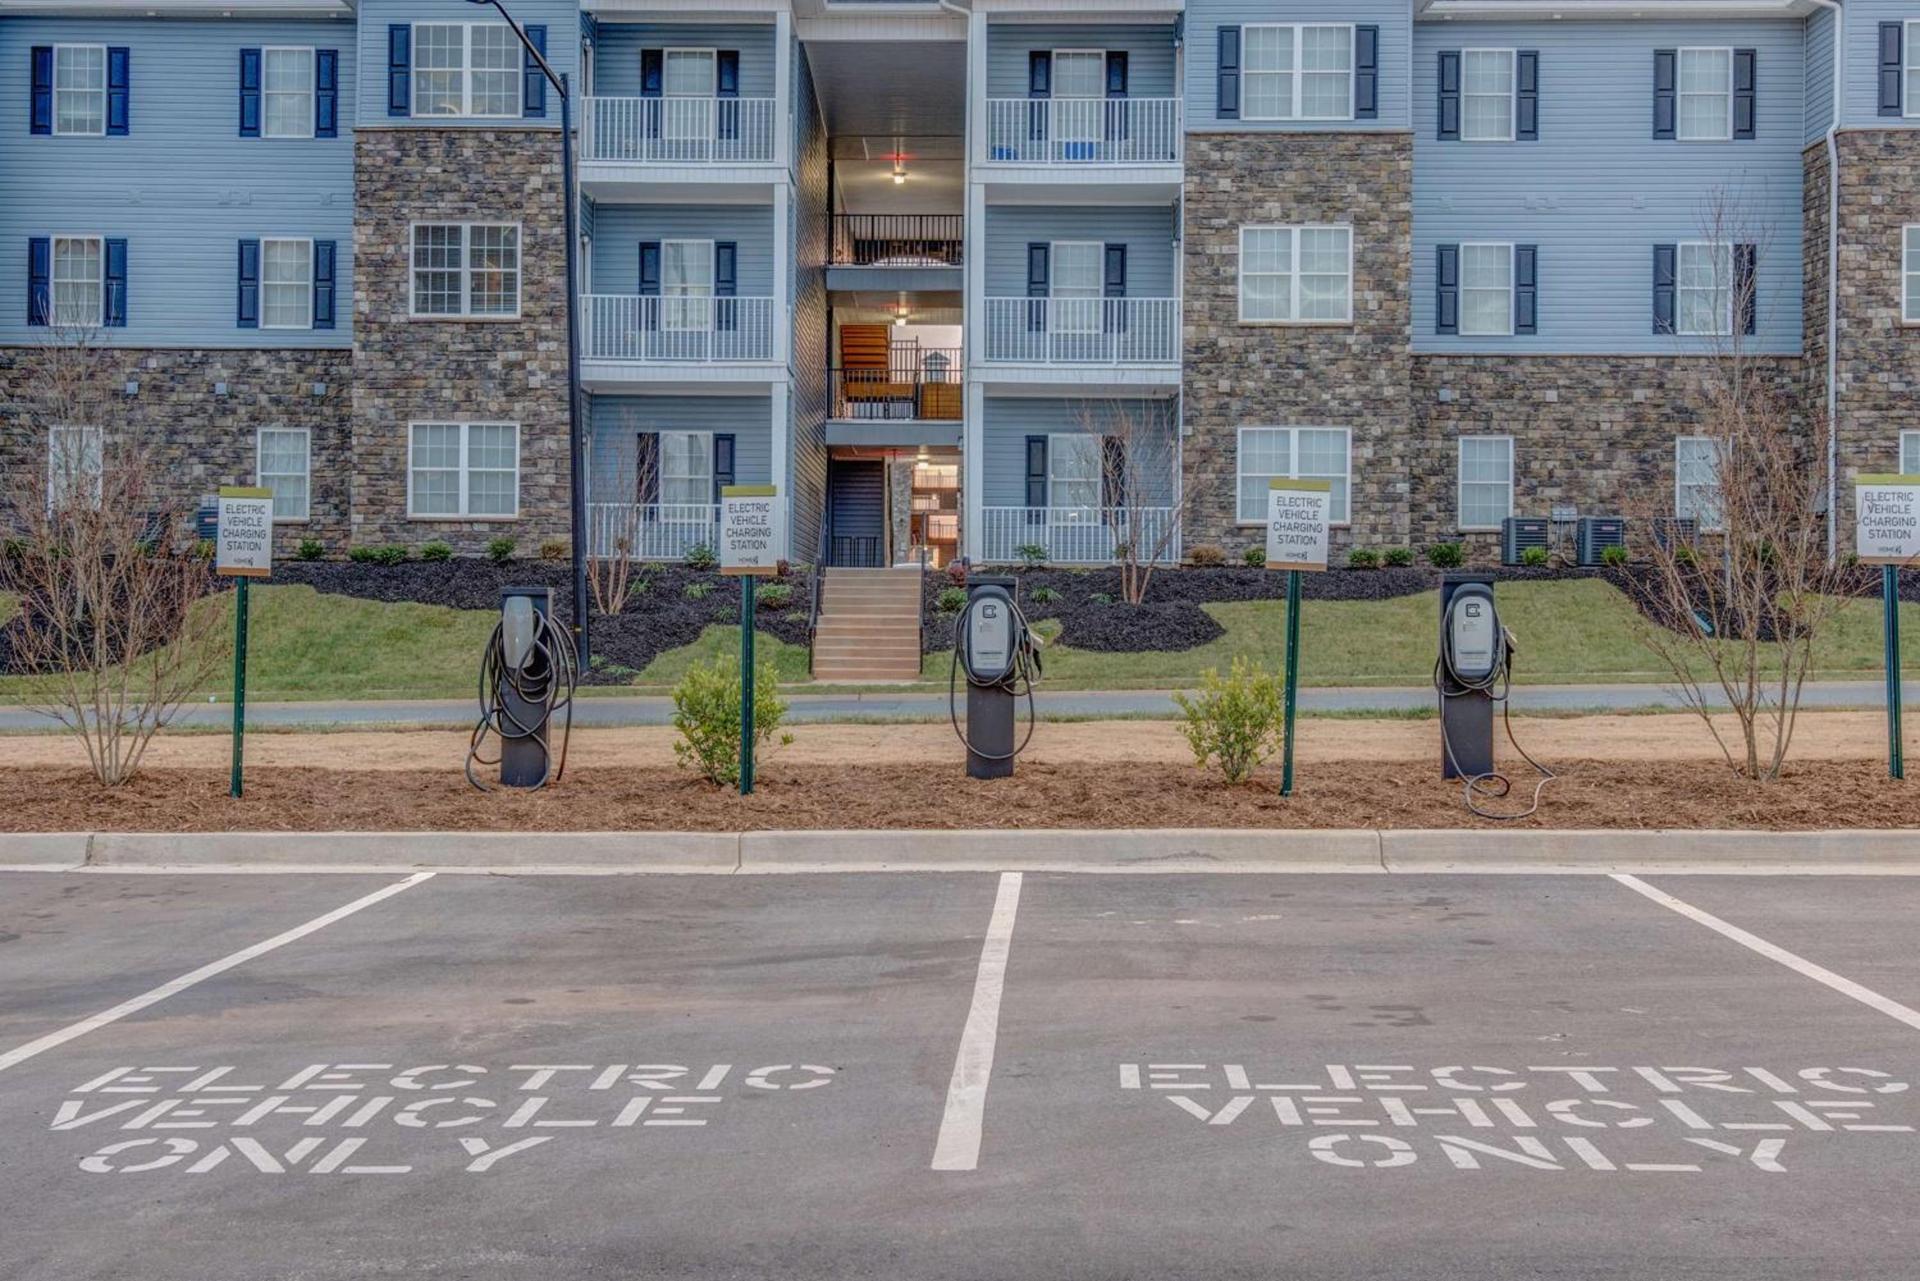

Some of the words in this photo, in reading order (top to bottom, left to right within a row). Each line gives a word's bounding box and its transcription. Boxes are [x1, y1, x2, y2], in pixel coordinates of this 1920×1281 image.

[1276, 496, 1323, 508] ELECTRIC
[1864, 491, 1914, 502] ELECTRIC
[225, 503, 266, 515] ELECTRIC
[728, 503, 770, 513] ELECTRIC
[1867, 503, 1912, 514] VEHICLE
[730, 515, 768, 525] VEHICLE
[1278, 509, 1320, 521] VEHICLE
[227, 516, 263, 527] VEHICLE
[1272, 521, 1323, 533] CHARGING
[1862, 516, 1917, 527] CHARGING
[222, 528, 267, 539] CHARGING
[726, 527, 772, 538] CHARGING
[1868, 529, 1912, 540] STATION
[730, 540, 767, 550] STATION
[1277, 534, 1318, 546] STATION
[226, 541, 262, 551] STATION
[69, 1063, 837, 1094] ELECTRIC
[1119, 1063, 1910, 1095] ELECTRIC
[49, 1095, 723, 1131] VEHICLE
[1165, 1095, 1917, 1133] VEHICLE
[78, 1136, 555, 1174] ONLY
[1307, 1133, 1788, 1173] ONLY
